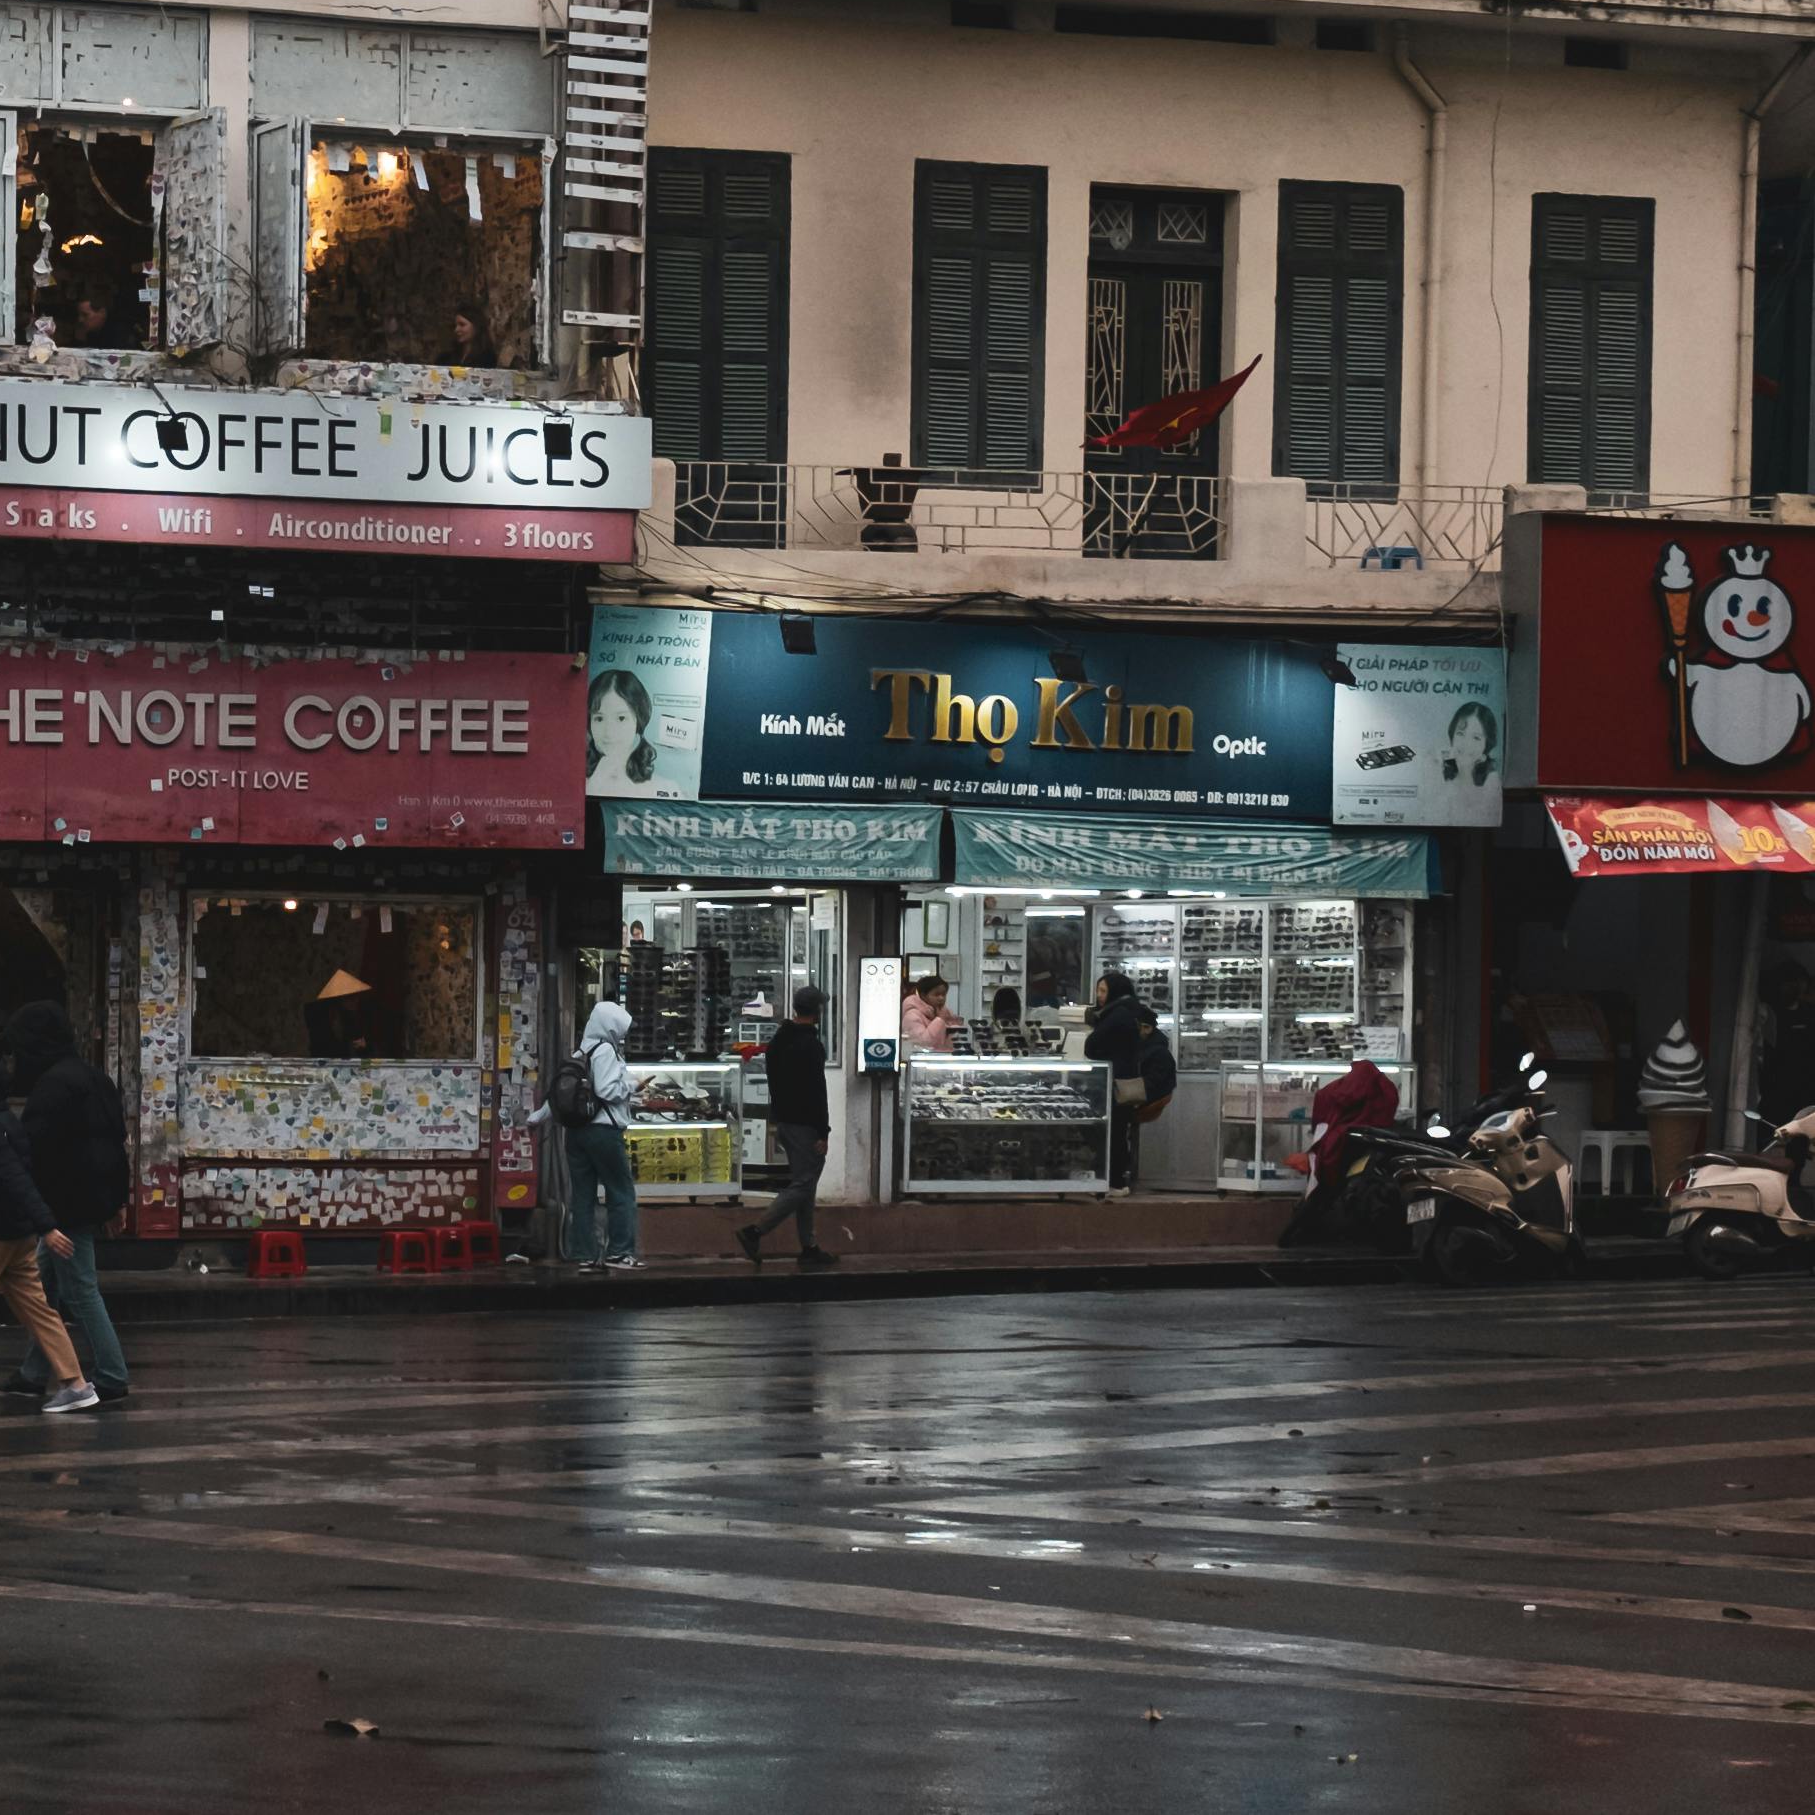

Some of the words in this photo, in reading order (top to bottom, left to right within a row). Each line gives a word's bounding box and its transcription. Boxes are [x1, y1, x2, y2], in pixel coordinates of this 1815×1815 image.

[121, 409, 358, 478] COFFEE
[158, 507, 212, 535] Wifi
[268, 512, 452, 546] Airconditioner
[504, 523, 518, 548] 3
[522, 523, 594, 550] floors
[89, 689, 257, 747] NOTE
[284, 694, 529, 753] COFFEE
[760, 713, 802, 735] Kính
[806, 712, 846, 737] Mắt
[870, 668, 1019, 763] Thọ
[1030, 677, 1195, 753] Kim
[1212, 734, 1267, 759] Optic
[168, 768, 247, 789] POST-IT
[252, 770, 309, 791] LOVE
[852, 775, 875, 789] CAN
[615, 809, 702, 840] KÍNH
